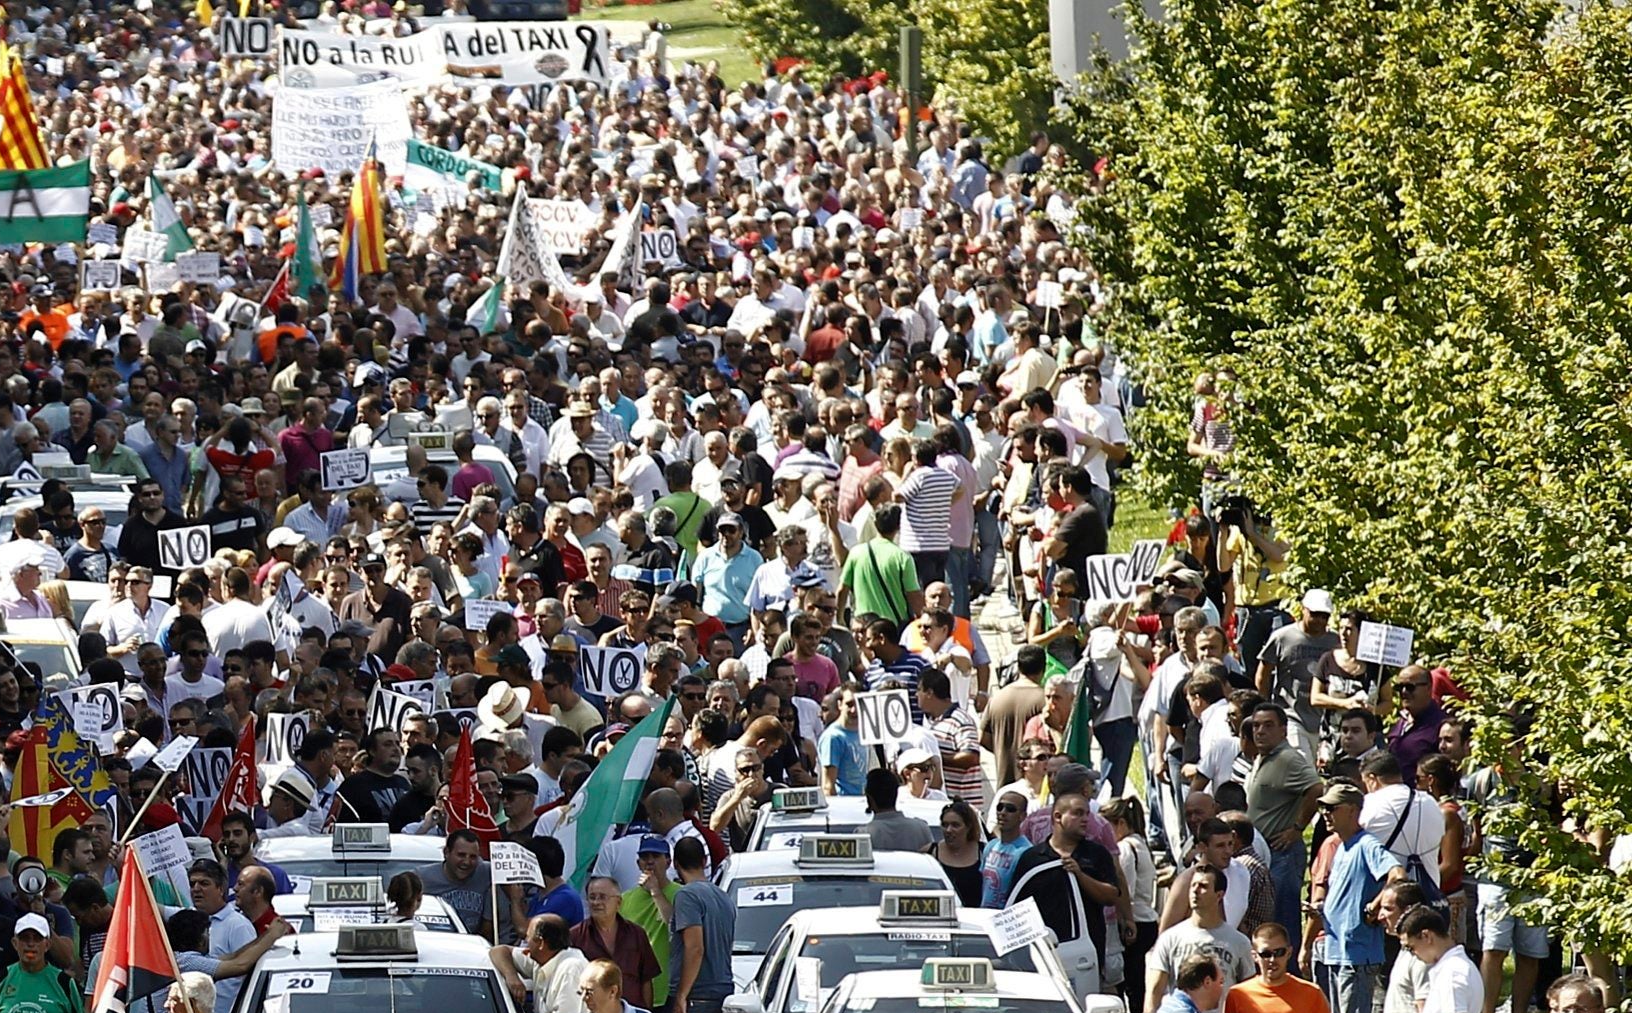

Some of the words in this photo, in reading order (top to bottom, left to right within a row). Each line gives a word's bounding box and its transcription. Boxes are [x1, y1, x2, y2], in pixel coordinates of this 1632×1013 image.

[223, 21, 270, 55] NO
[283, 38, 319, 66] NO
[329, 48, 344, 65] a
[352, 41, 374, 64] la
[468, 27, 508, 57] del
[510, 26, 570, 53] TAXI
[641, 233, 674, 259] NO
[161, 528, 210, 566] NO
[581, 649, 640, 694] NO
[860, 692, 910, 741] NO
[266, 714, 309, 762] NO
[188, 750, 232, 798] NO
[785, 792, 806, 806] TAXI
[491, 852, 503, 860] NO
[817, 839, 857, 857] TAXI
[495, 861, 516, 871] DEL
[328, 883, 366, 899] TAXI
[753, 891, 780, 901] 44
[900, 897, 939, 915] TAXI
[356, 930, 398, 946] TAXI
[428, 968, 489, 978] RADIO-TAXI
[938, 965, 971, 983] TAXI
[287, 977, 315, 989] 20
